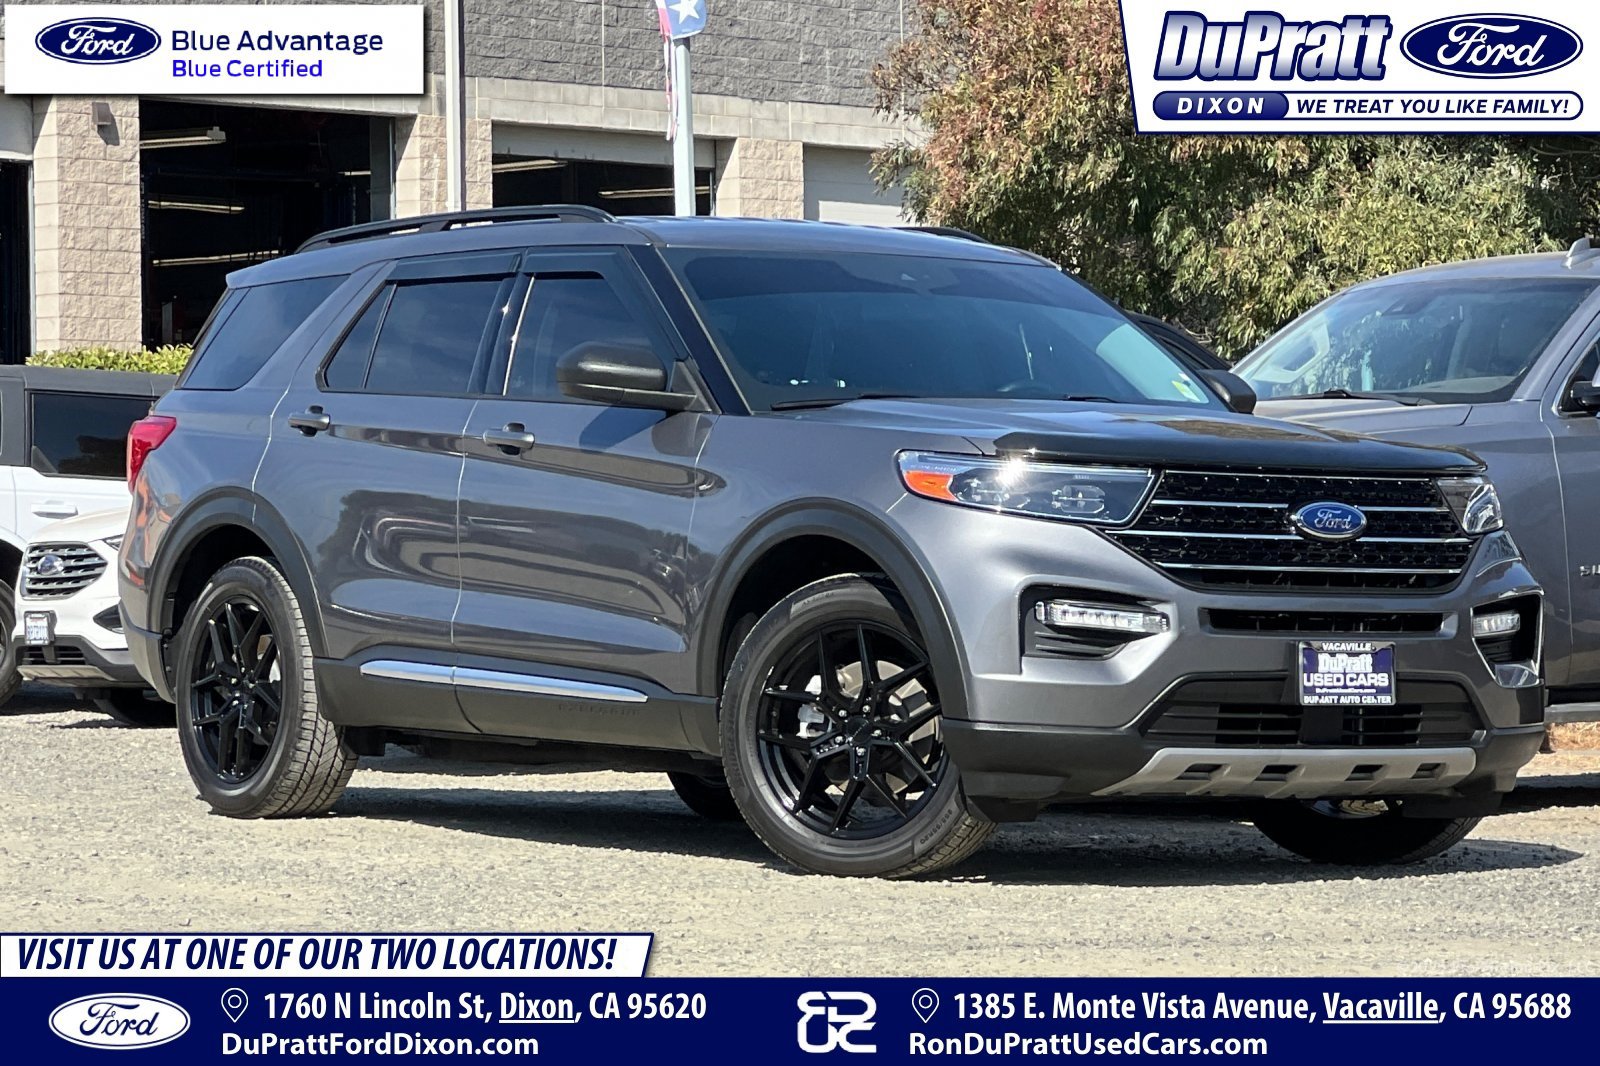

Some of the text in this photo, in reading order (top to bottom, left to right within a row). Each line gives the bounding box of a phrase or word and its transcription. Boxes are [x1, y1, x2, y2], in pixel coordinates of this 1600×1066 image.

[1314, 508, 1352, 529] Ford
[1579, 564, 1600, 577] SI
[1322, 642, 1372, 651] VACAVILLE
[1317, 652, 1373, 673] DuPratt
[1303, 673, 1389, 687] USED CARS
[1340, 695, 1360, 704] AUTO
